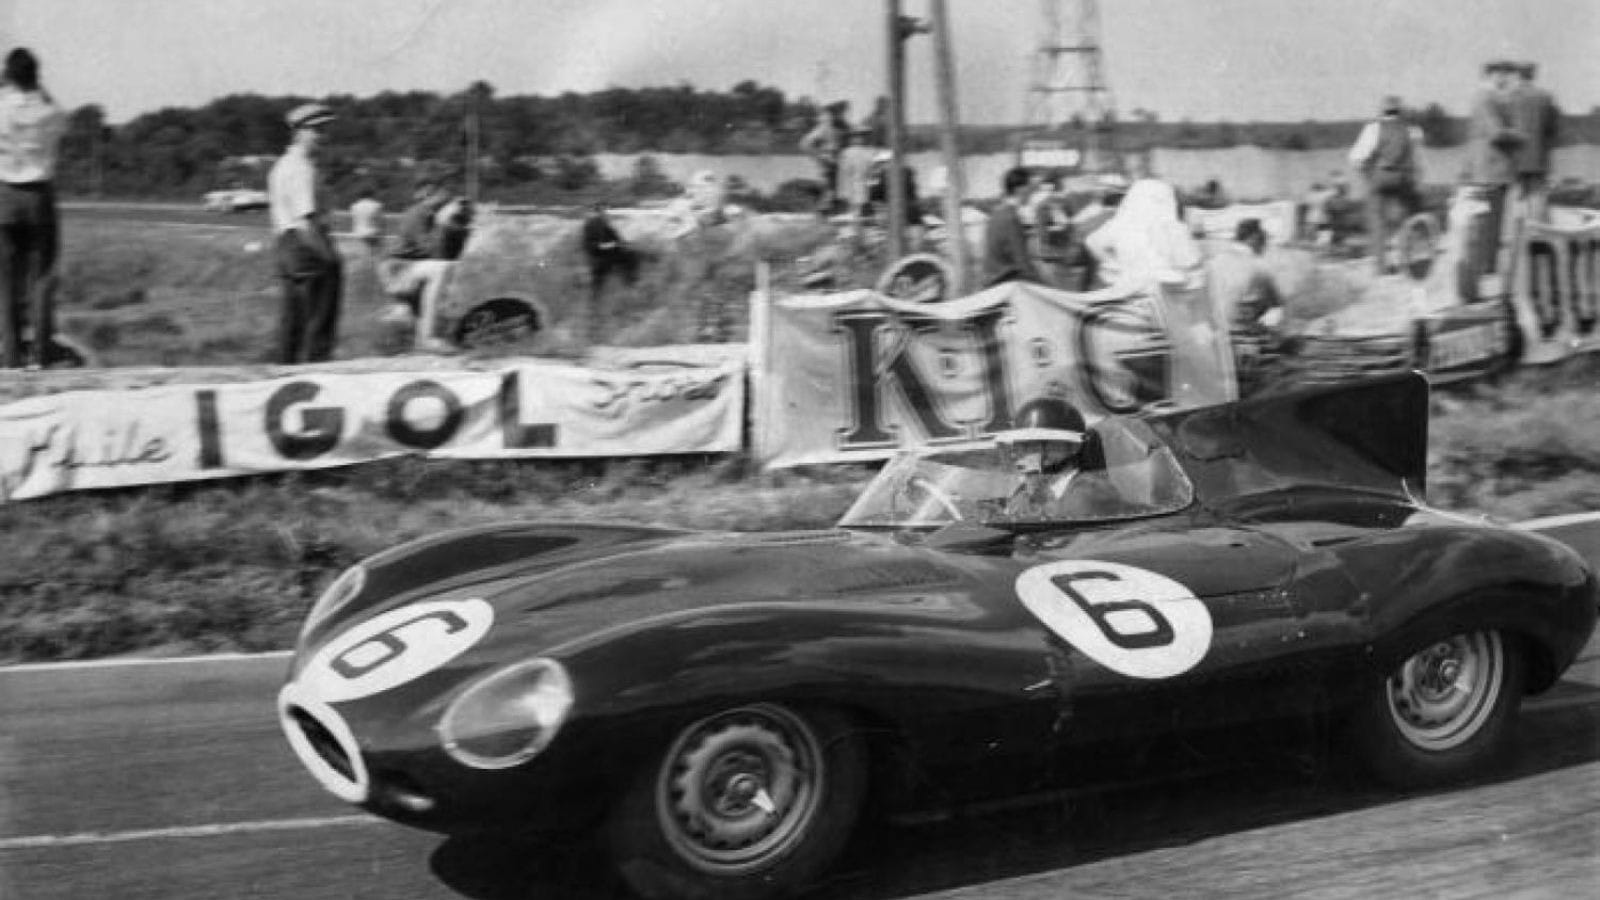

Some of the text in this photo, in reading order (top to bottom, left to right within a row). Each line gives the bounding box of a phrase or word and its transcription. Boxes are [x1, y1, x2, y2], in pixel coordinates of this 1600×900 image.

[195, 369, 557, 470] IGOL
[329, 610, 469, 679] 6
[1050, 571, 1175, 650] 6
